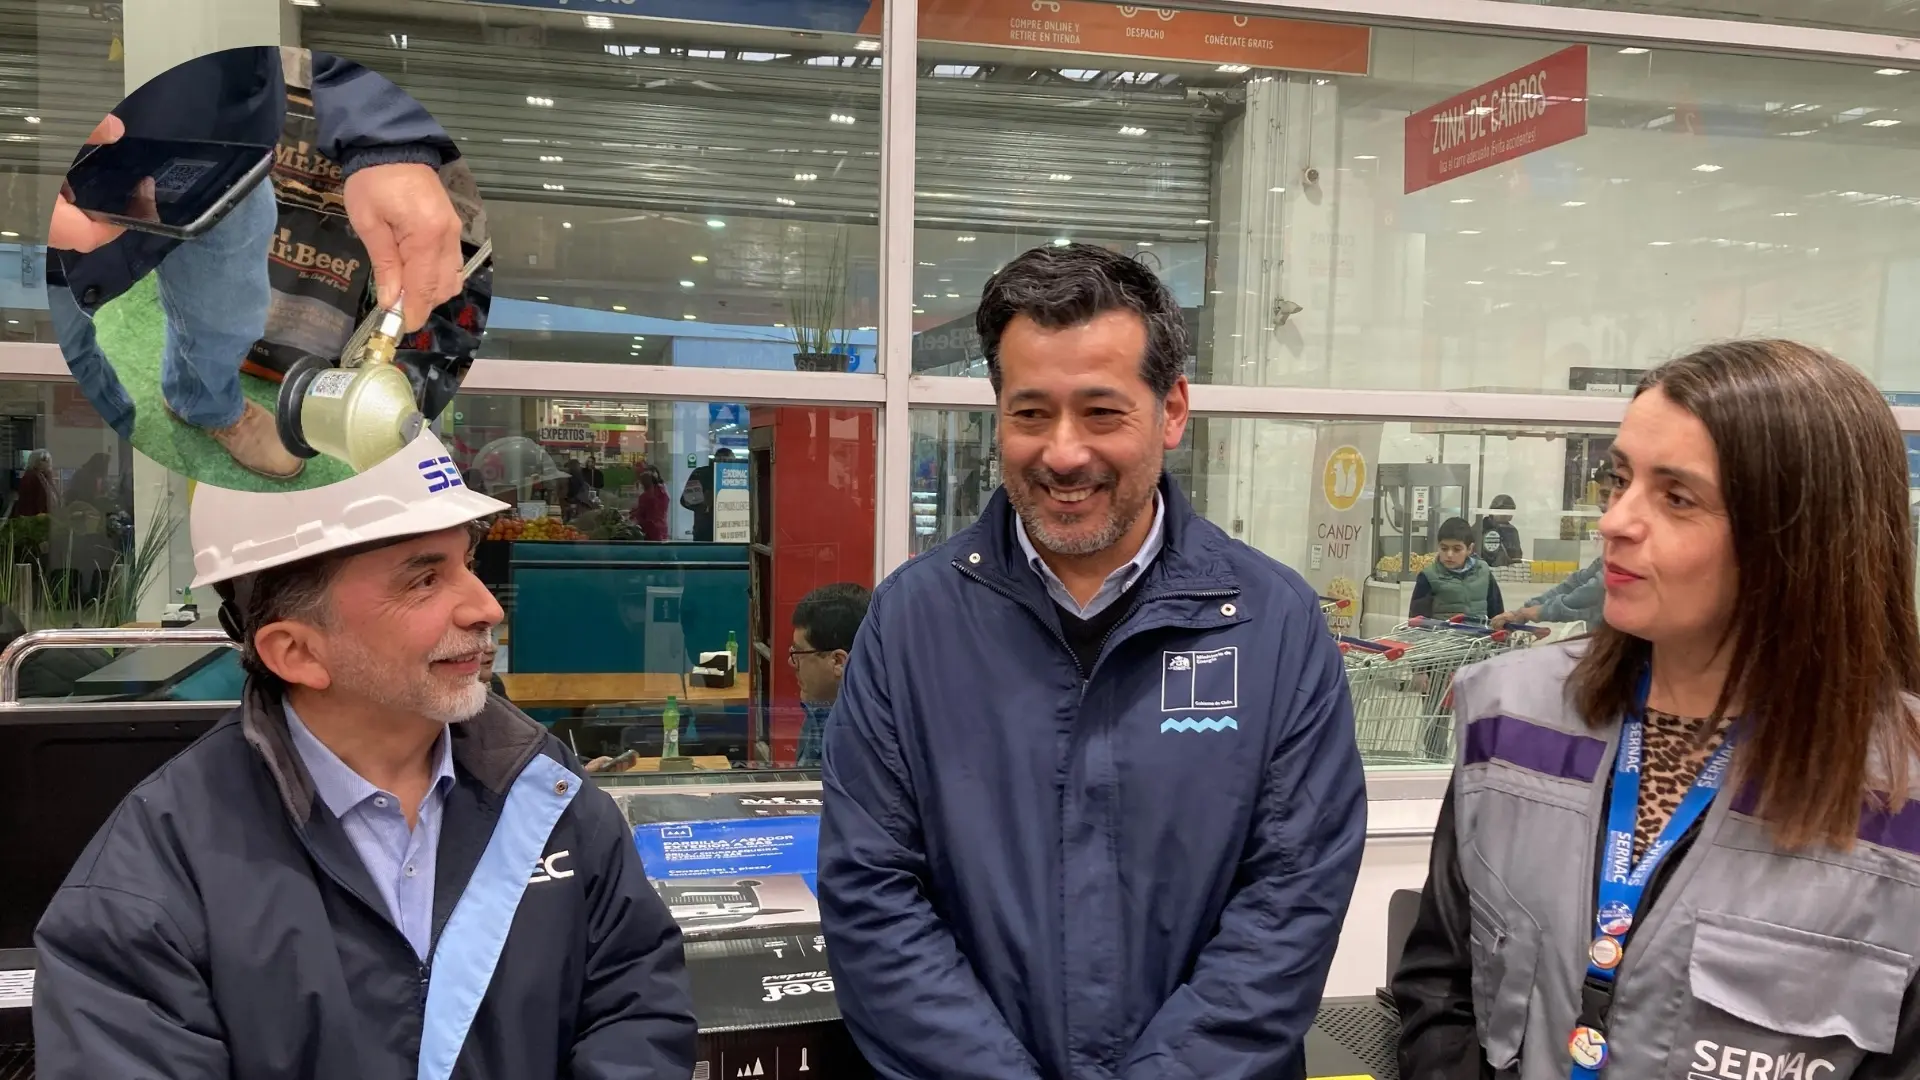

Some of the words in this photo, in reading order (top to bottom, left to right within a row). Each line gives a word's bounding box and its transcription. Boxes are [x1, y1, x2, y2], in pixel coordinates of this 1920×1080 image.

[1010, 18, 1042, 30] COMPRE
[1044, 20, 1072, 32] ONLINE
[1074, 23, 1080, 33] Y
[1126, 26, 1165, 40] DESPACHO
[1010, 30, 1037, 41] RETIRE
[1040, 32, 1050, 42] EN
[1053, 33, 1081, 45] TIENDA
[1204, 33, 1246, 47] CONÉCTATE
[1247, 38, 1274, 50] GRATIS
[1432, 103, 1467, 155] ZONA
[1470, 94, 1488, 141] DE
[1491, 70, 1547, 133] CARROS
[275, 143, 343, 179] Mr.Be
[541, 428, 585, 441] EXPERTOS
[418, 455, 463, 493] SE
[1317, 523, 1362, 541] CANDY
[1327, 543, 1350, 559] NUT
[1625, 722, 1642, 773] SERNAC
[1613, 831, 1632, 885] SERNAC
[1627, 840, 1669, 886] SERNAC
[762, 980, 835, 1002] eef
